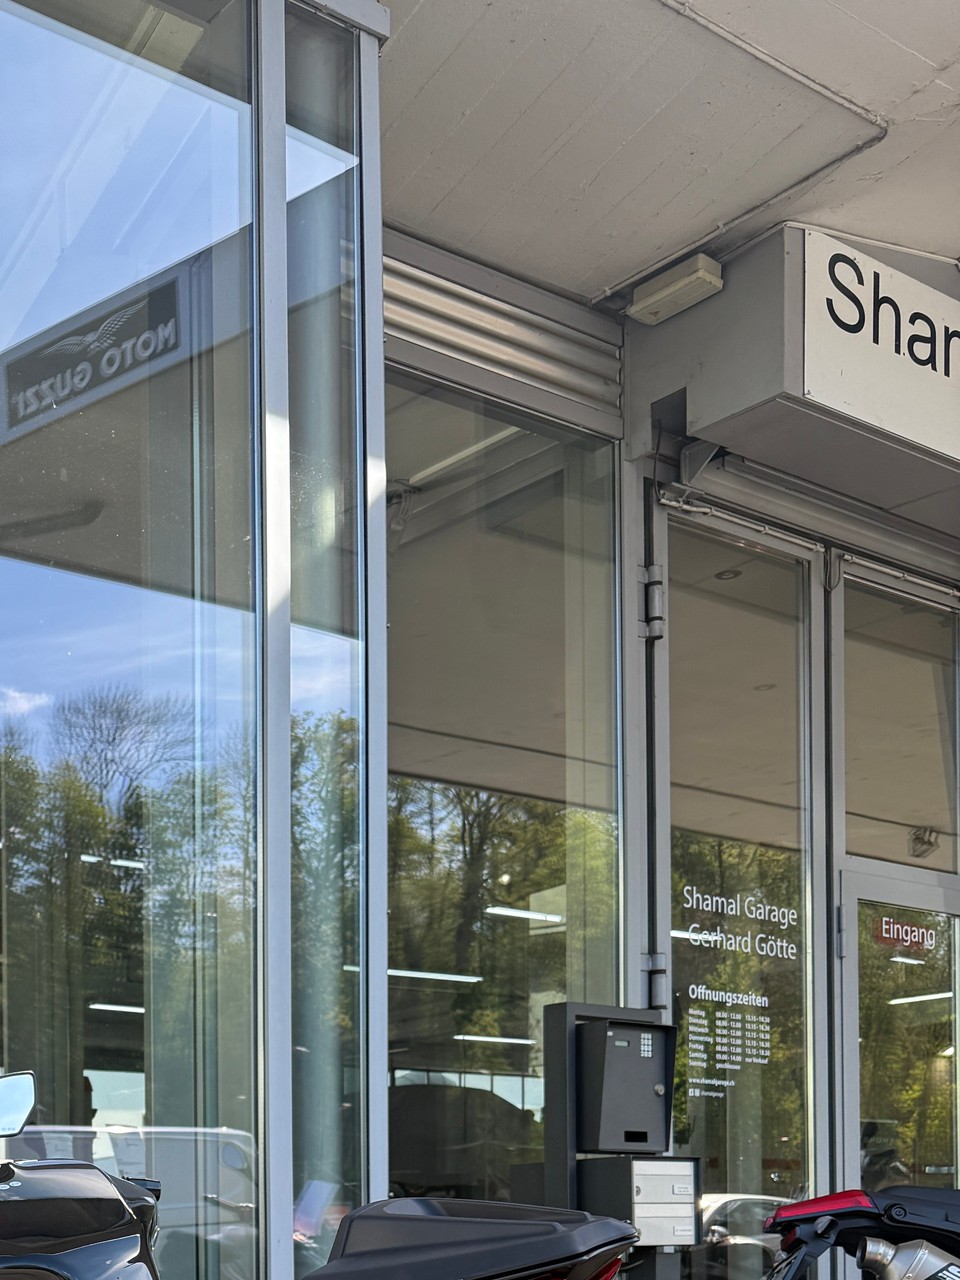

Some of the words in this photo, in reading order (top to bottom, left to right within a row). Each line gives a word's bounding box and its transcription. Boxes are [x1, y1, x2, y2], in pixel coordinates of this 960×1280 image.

[683, 885, 740, 916] Shamal
[744, 896, 797, 929] Garage
[688, 923, 751, 954] Gerhard
[755, 933, 797, 960] Götte
[882, 916, 936, 950] Eingang
